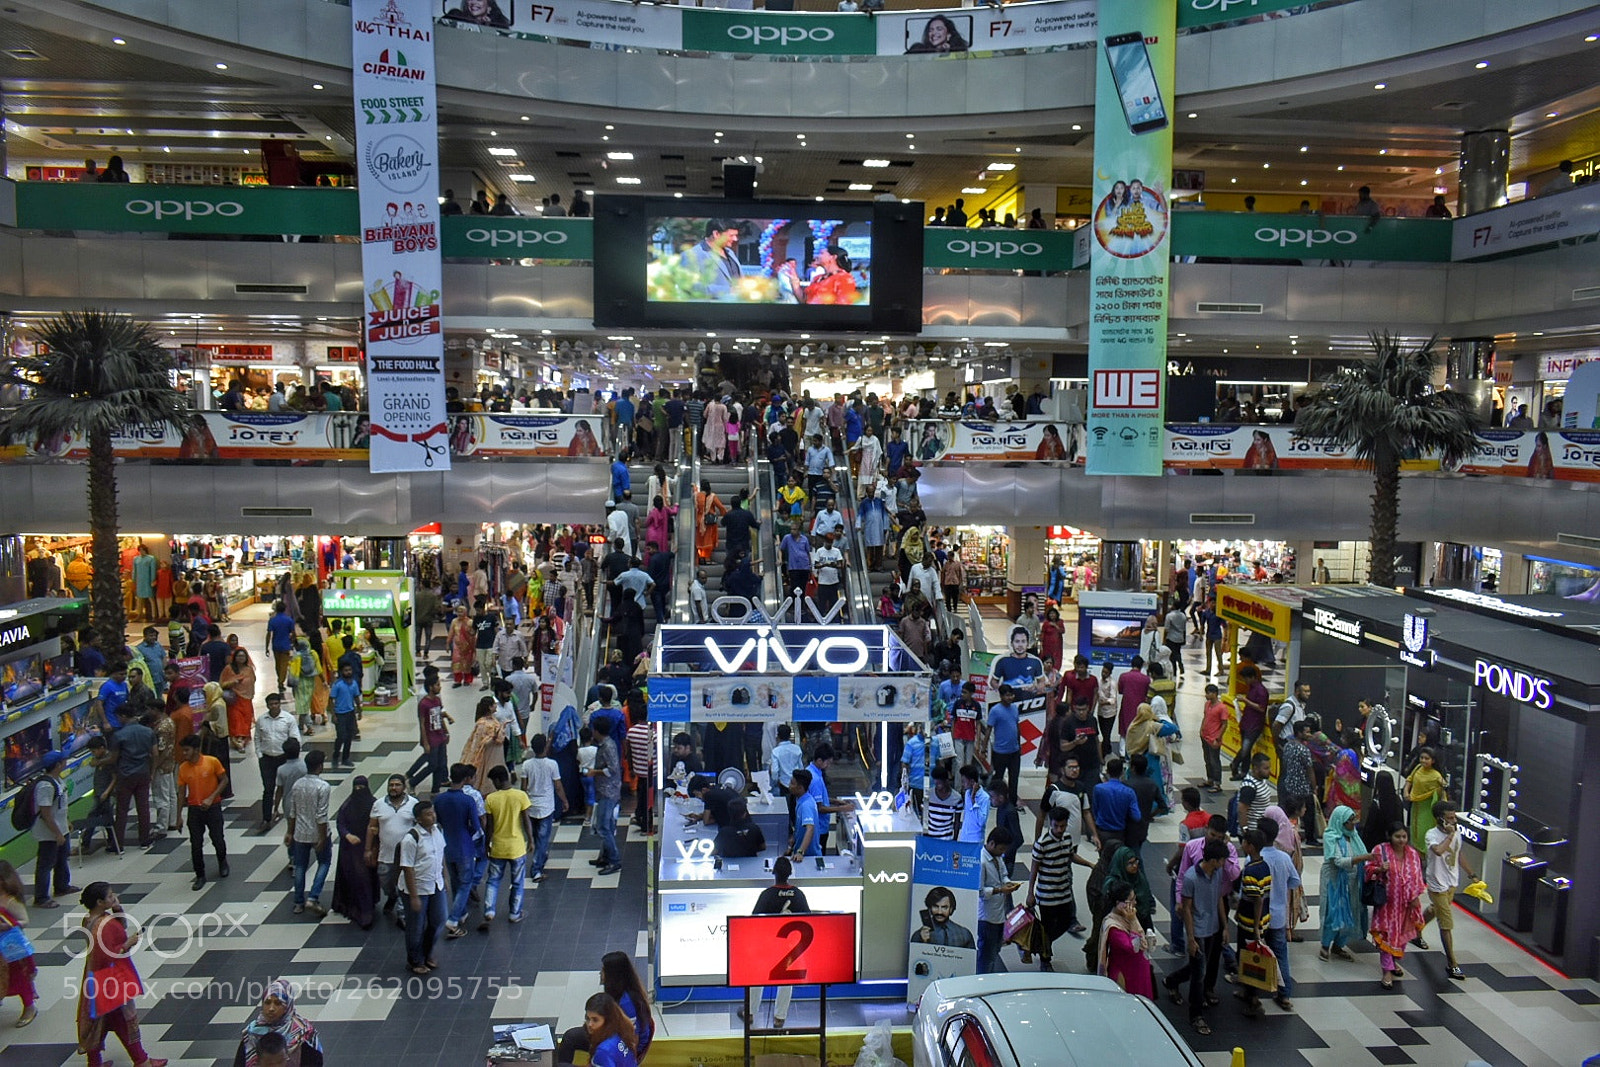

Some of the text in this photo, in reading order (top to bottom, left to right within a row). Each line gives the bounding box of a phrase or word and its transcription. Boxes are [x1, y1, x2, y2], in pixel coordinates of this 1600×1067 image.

[531, 5, 554, 23] F7
[618, 16, 636, 24] selfie
[1077, 11, 1096, 20] selfie
[386, 25, 430, 42] THAI
[576, 18, 604, 29] Capture
[605, 22, 616, 30] the
[617, 24, 631, 32] real
[990, 20, 1012, 37] F7
[1034, 23, 1062, 33] Capture
[1063, 21, 1075, 30] the
[1076, 20, 1090, 28] real
[727, 25, 835, 46] oppo
[363, 62, 425, 80] CIPRIANI
[361, 96, 424, 109] FOOD STREET
[373, 146, 431, 173] Bakery
[388, 169, 417, 180] ISLAND
[125, 199, 244, 221] oppo
[466, 228, 568, 248] oppo
[1254, 227, 1358, 248] oppo
[1473, 226, 1492, 248] F7
[1532, 225, 1543, 234] the
[394, 236, 437, 253] BOYS
[946, 239, 1043, 259] oppo
[378, 306, 431, 323] JUICE
[1095, 303, 1120, 311] ১২০০
[379, 321, 431, 340] JUICE
[378, 359, 435, 370] THE FOOD HALL
[1094, 370, 1160, 409] WE
[383, 398, 431, 410] GRAND
[383, 412, 431, 422] OPENING
[229, 429, 298, 442] JOTEY
[323, 594, 391, 610] minister
[704, 626, 869, 674] vivo
[1474, 659, 1554, 709] POND'S
[647, 691, 688, 703] vivo
[795, 691, 836, 703] vivo
[854, 791, 894, 811] V9
[675, 839, 715, 860] V9
[915, 851, 944, 863] vivo
[868, 870, 909, 883] vivo
[768, 920, 815, 981] 2
